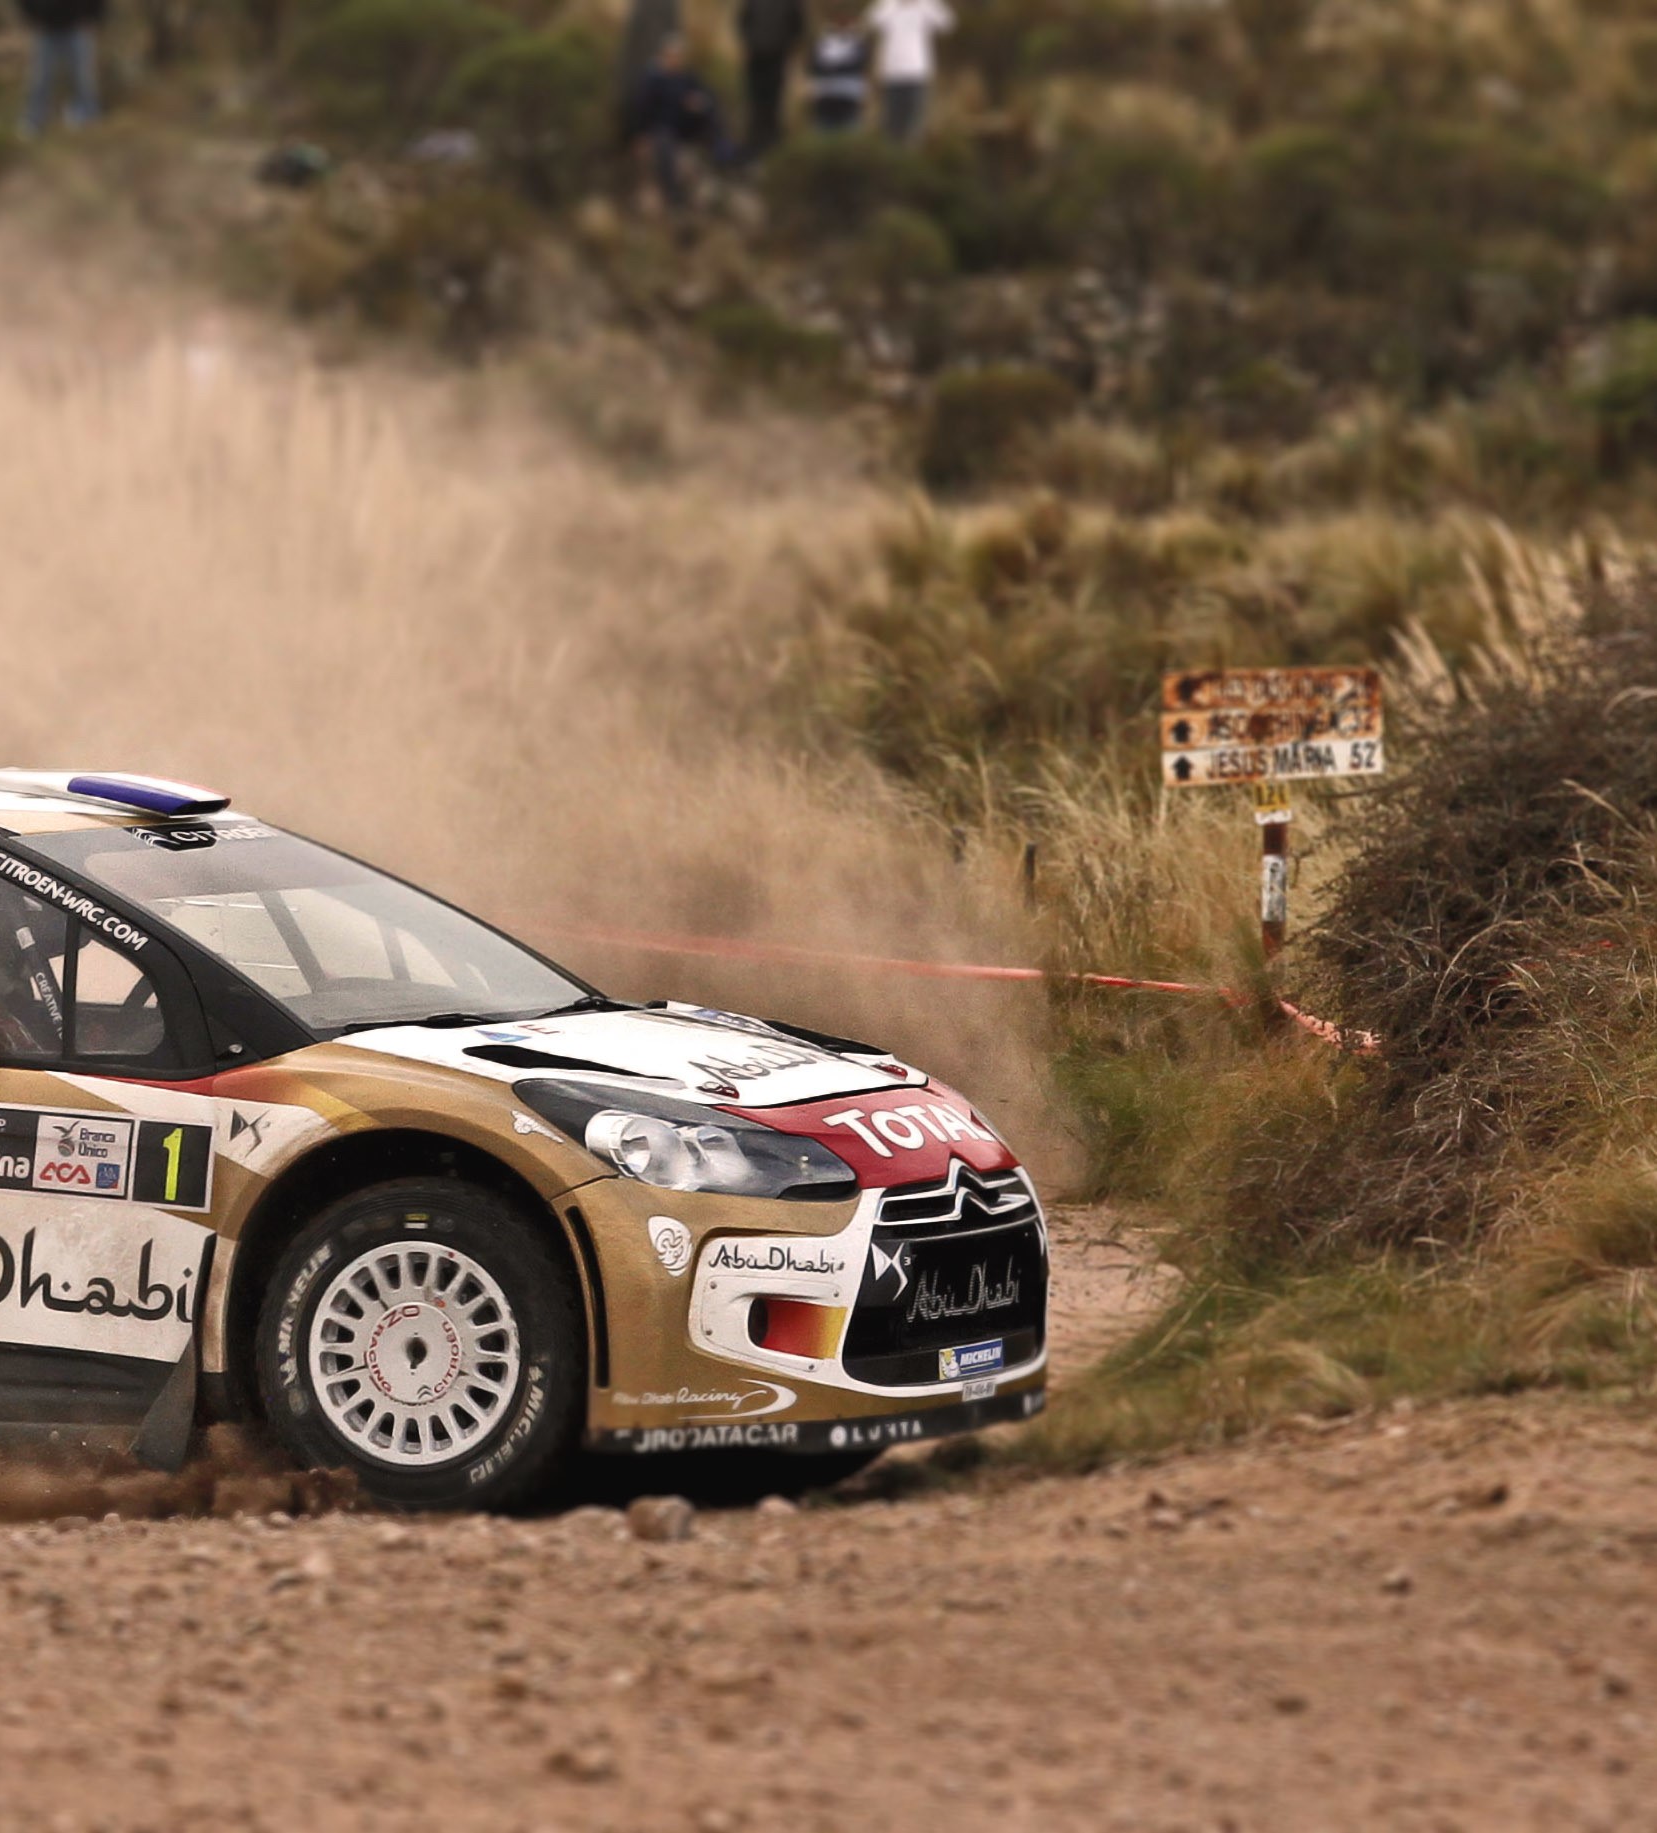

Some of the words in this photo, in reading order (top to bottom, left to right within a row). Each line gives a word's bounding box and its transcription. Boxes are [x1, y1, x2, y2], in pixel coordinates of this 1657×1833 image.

[1350, 742, 1376, 770] 52
[822, 1103, 995, 1158] TOTAL
[39, 1161, 91, 1185] ACA
[163, 1127, 184, 1201] 1
[960, 1346, 1002, 1366] MICHELIN
